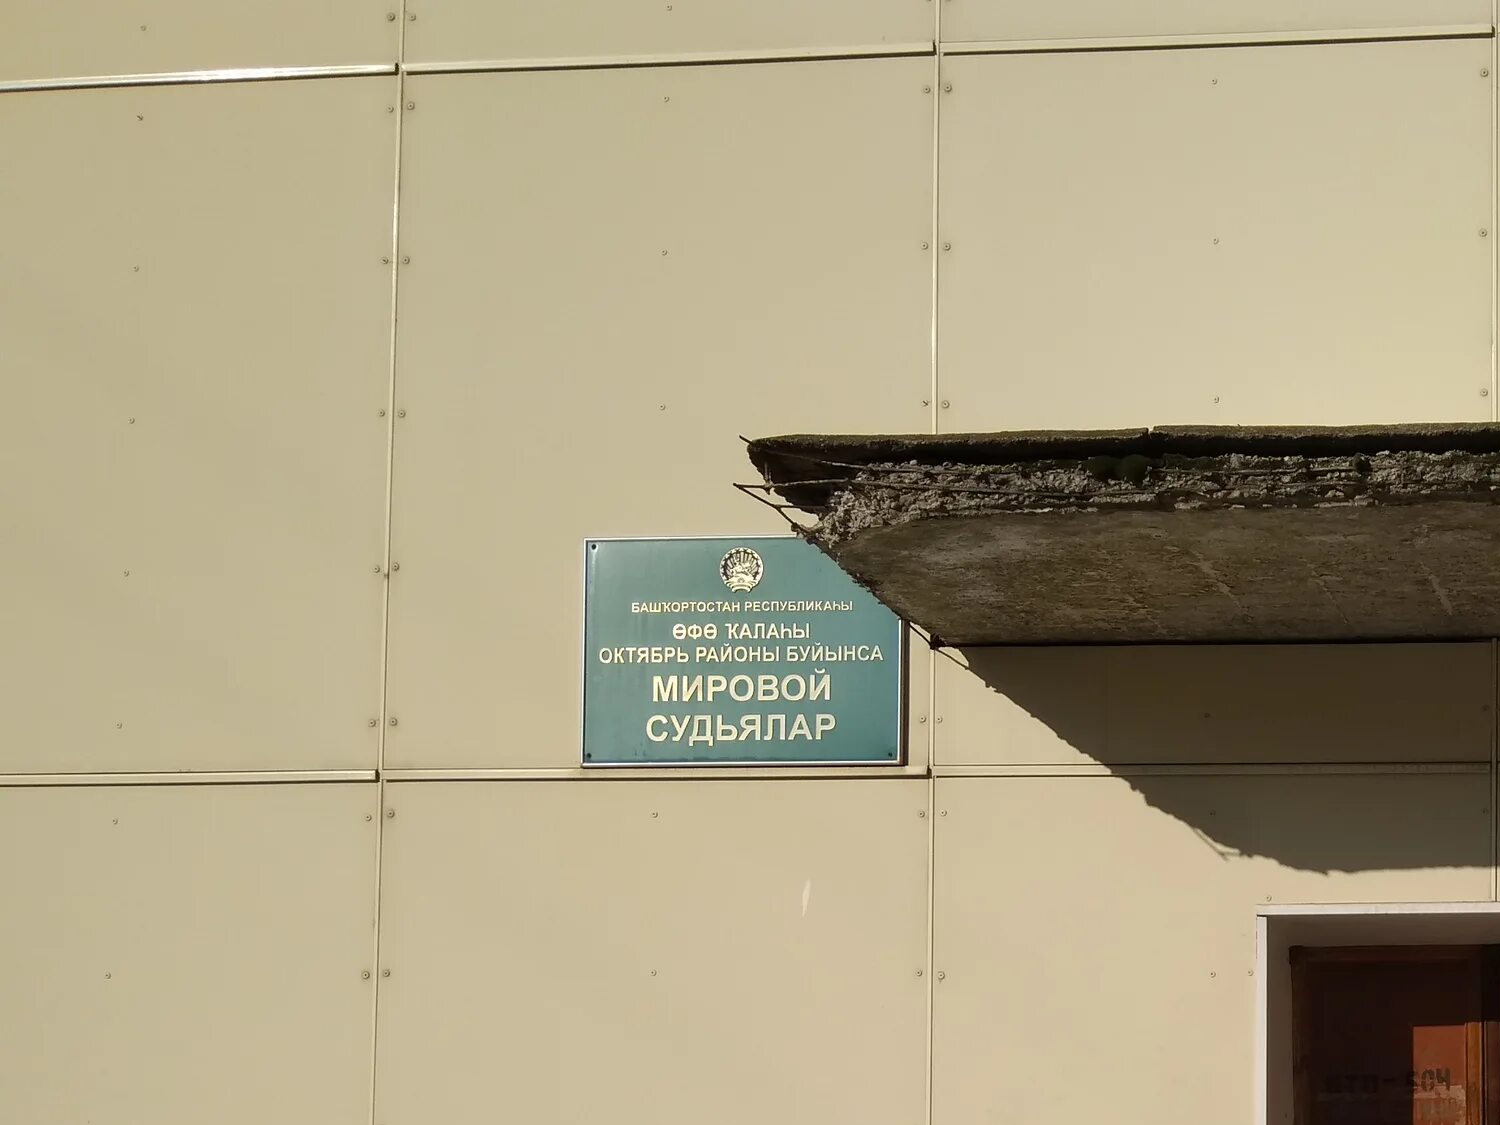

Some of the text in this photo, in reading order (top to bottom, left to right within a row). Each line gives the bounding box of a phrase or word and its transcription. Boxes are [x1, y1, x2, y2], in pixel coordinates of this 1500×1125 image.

[632, 602, 741, 613] БАШҠОРТОСТАН
[673, 623, 811, 639] ӨФӨ ҠАЛАҺЫ
[599, 642, 884, 664] ОКТЯБРЬ РАЙОНЫ БУЙЫНСА
[652, 668, 832, 702] МИРОВОЙ
[646, 713, 837, 746] СУДЬЯЛАР
